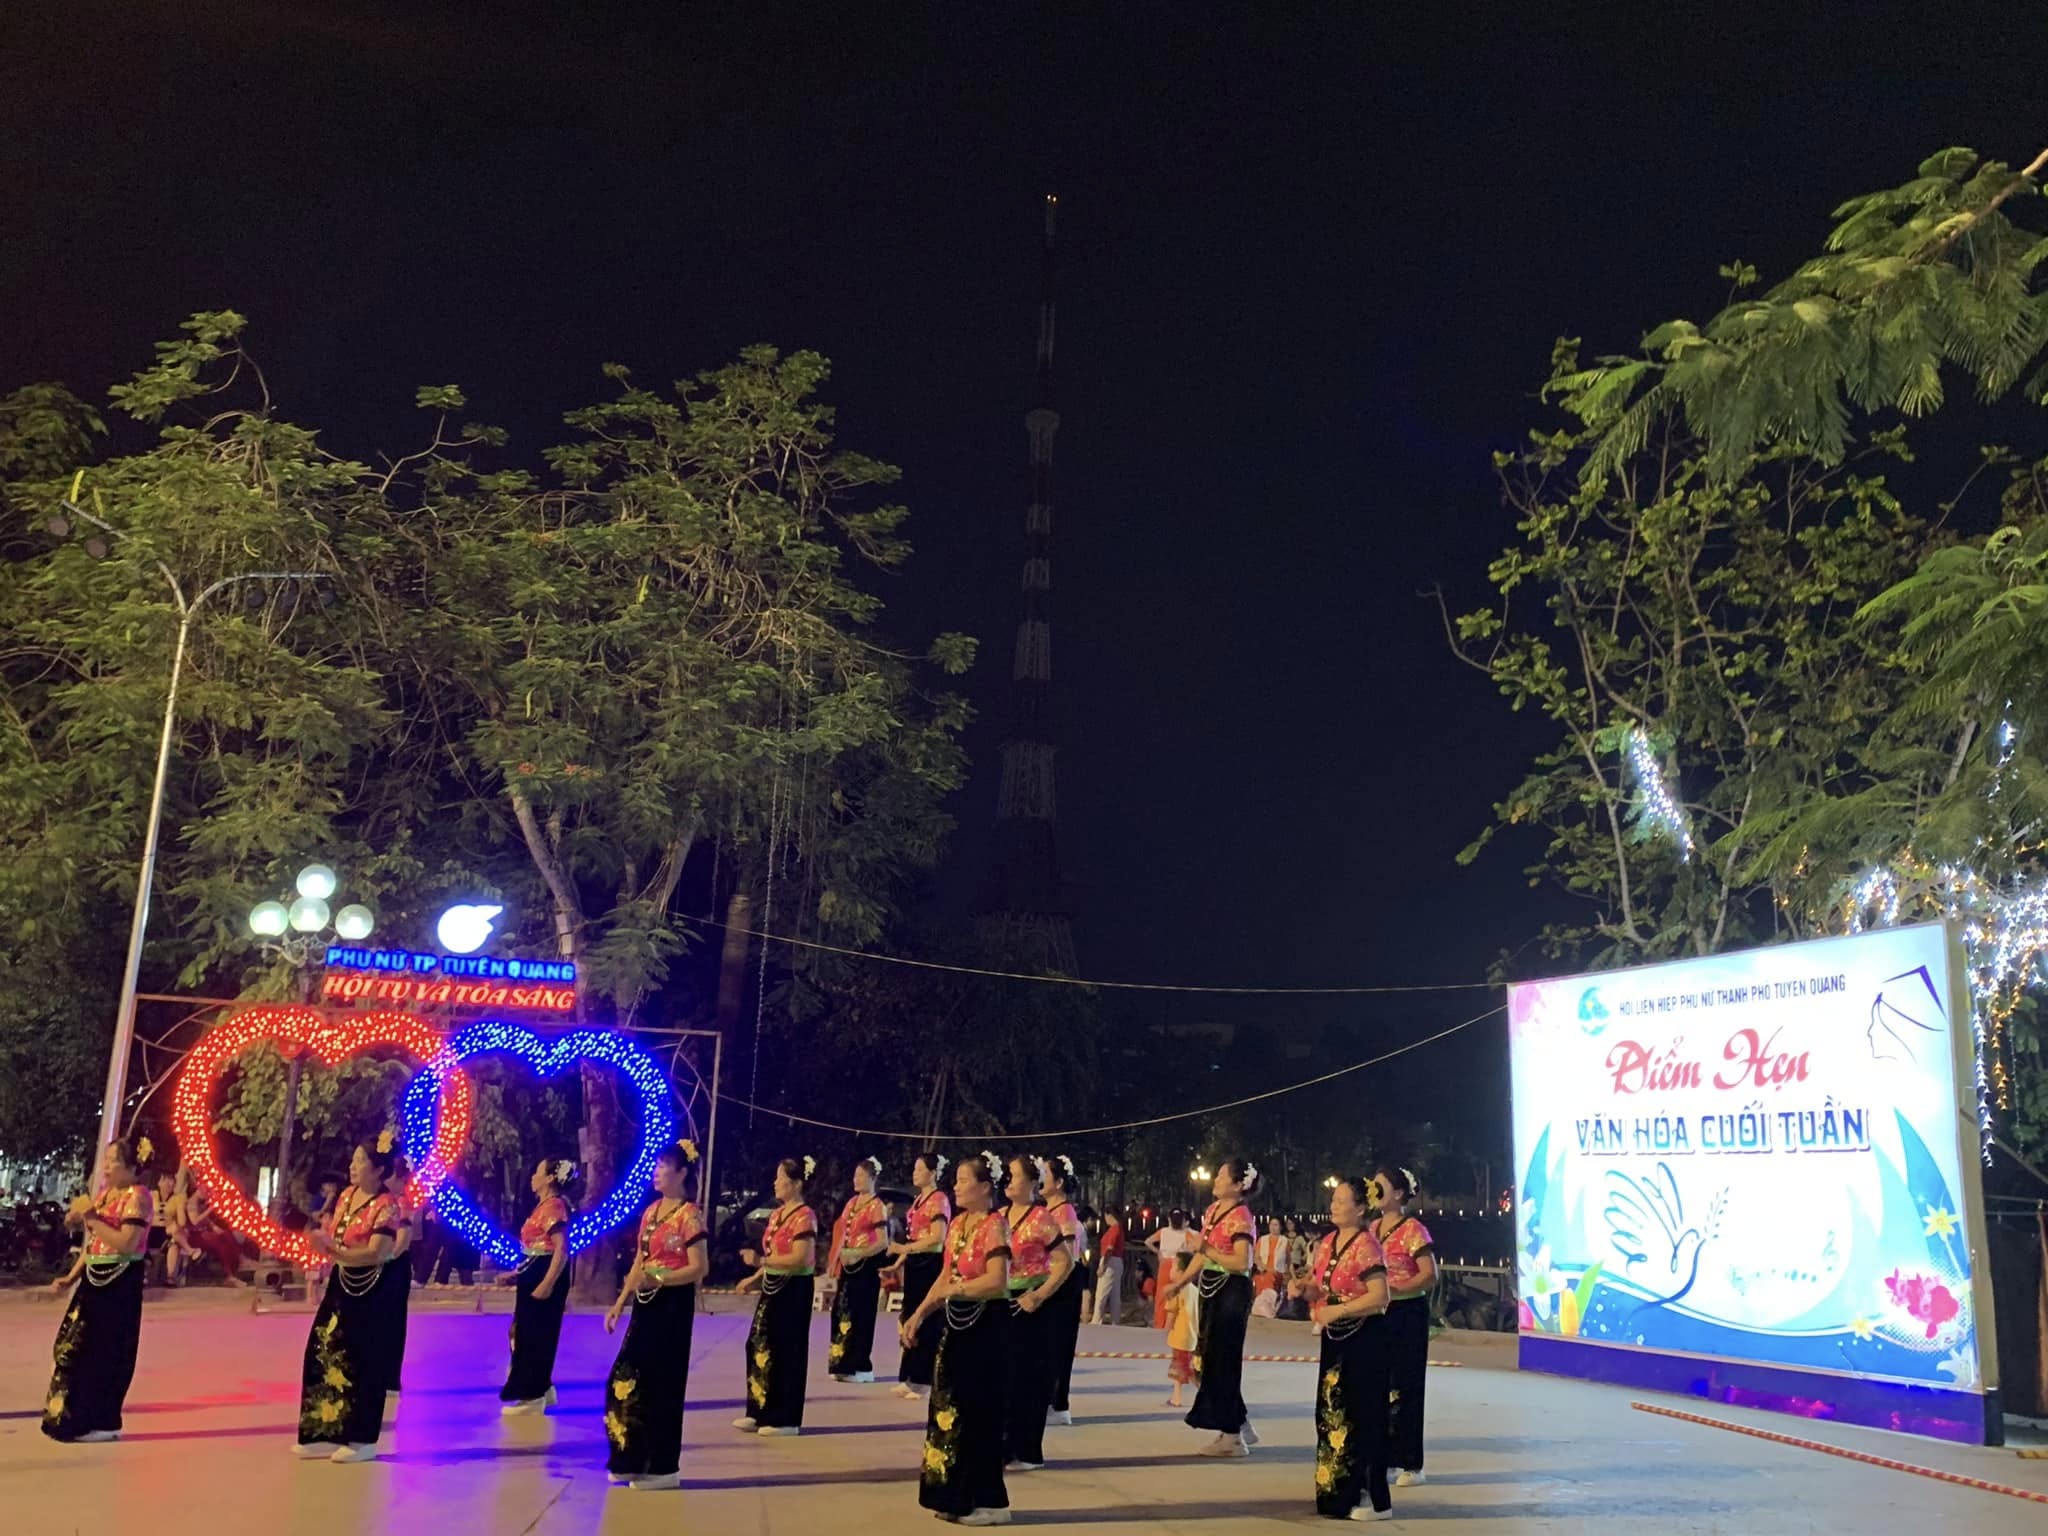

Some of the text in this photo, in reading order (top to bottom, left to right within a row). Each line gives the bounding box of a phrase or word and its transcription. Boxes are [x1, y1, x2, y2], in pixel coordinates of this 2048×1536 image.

[413, 955, 437, 971] TP
[443, 957, 505, 976] TUYÊN
[508, 960, 575, 980] QUANG
[1808, 974, 1846, 996] QUANG
[323, 973, 374, 1002] HỘI
[377, 980, 412, 1004] TỤ
[415, 979, 452, 1001] VÀ
[509, 984, 575, 1009] SÁNG
[1604, 1025, 1810, 1094] Điểm Hẹn
[1575, 1096, 1869, 1154] VĂN HÓA CUỐI TUẦN
